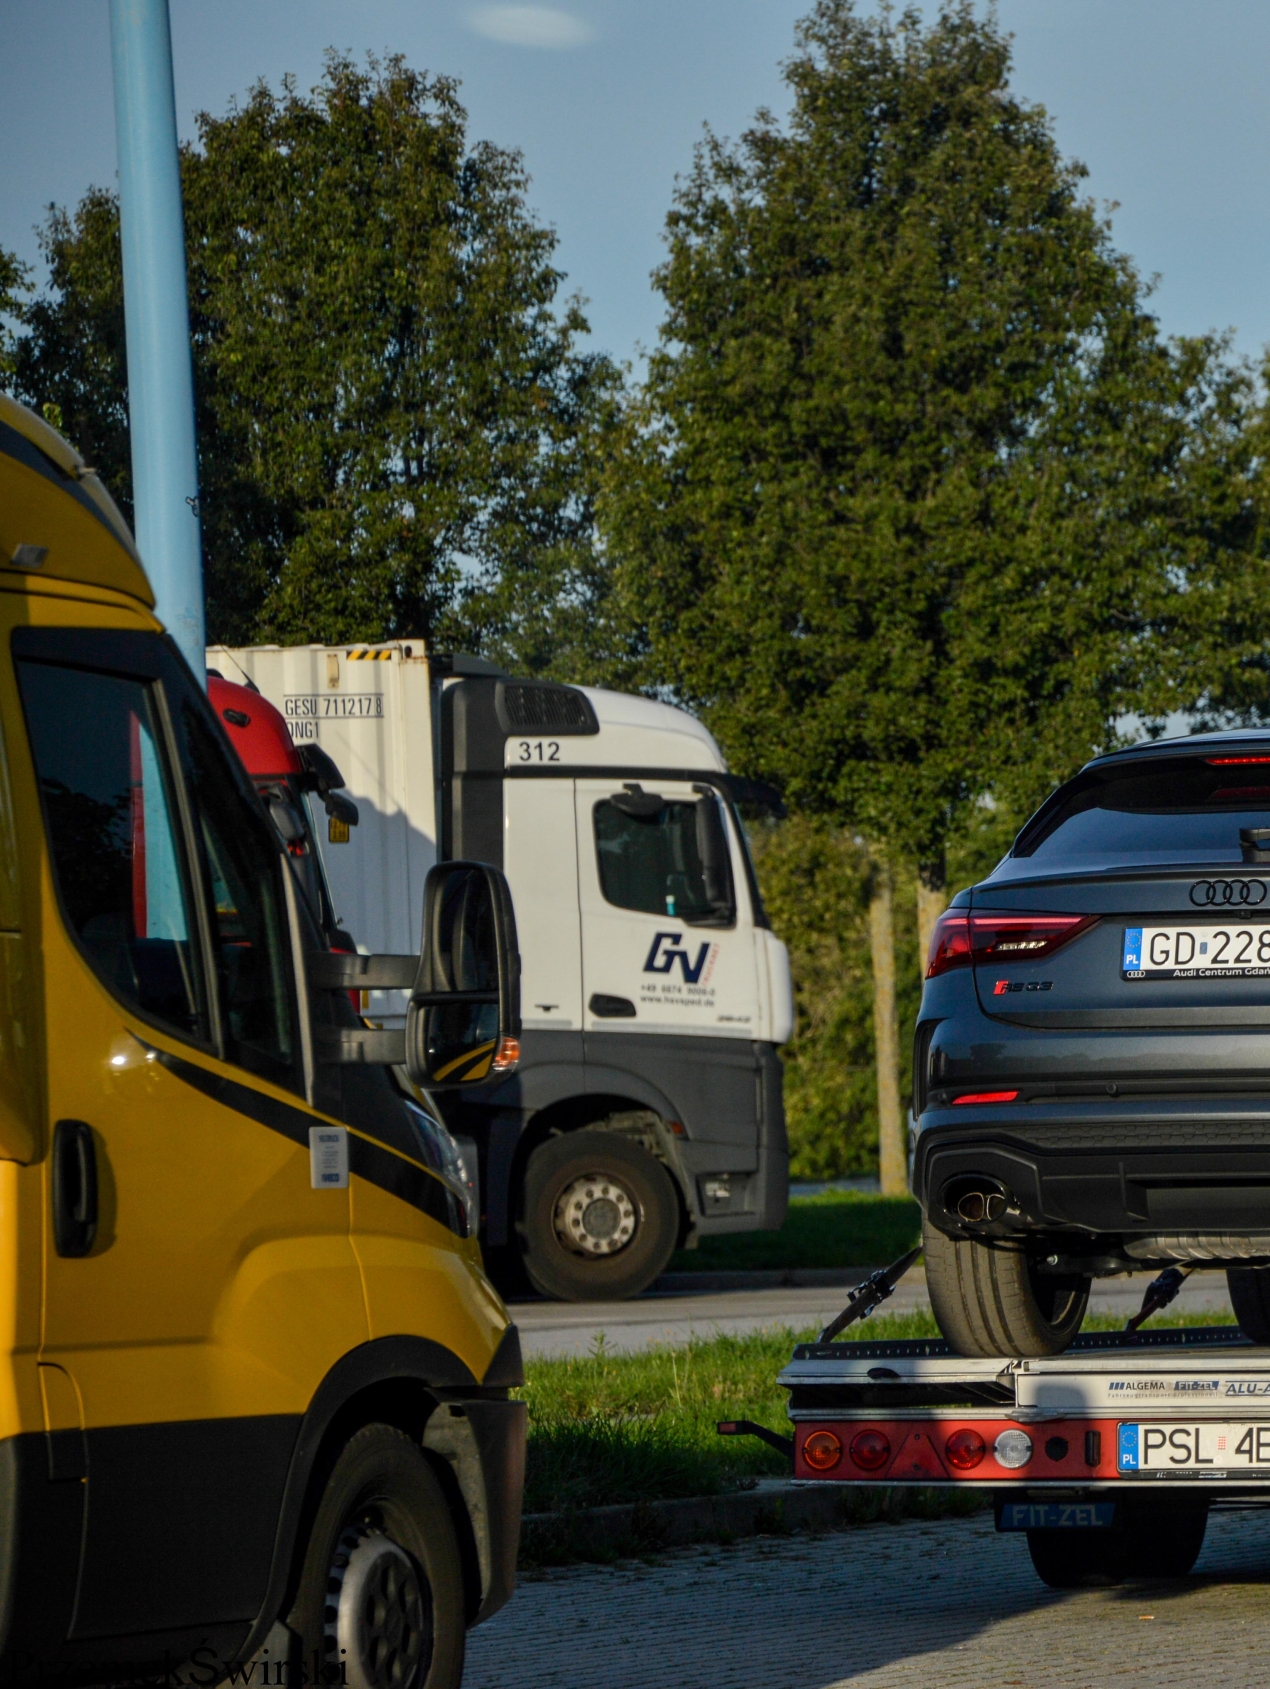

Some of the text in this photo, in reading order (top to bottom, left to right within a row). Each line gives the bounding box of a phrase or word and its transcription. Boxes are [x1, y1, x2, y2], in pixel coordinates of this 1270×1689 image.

[285, 698, 317, 716] GESU
[519, 741, 560, 762] 312
[1149, 931, 1196, 966] GD
[1126, 954, 1139, 965] PL
[1173, 969, 1197, 977] Audi
[1199, 968, 1242, 976] Centrum
[1125, 1381, 1217, 1391] ALGEMA FIT-ZEL
[1143, 1427, 1214, 1465] PSL
[1122, 1454, 1137, 1465] PL
[1012, 1504, 1103, 1526] FIT-ZEL
